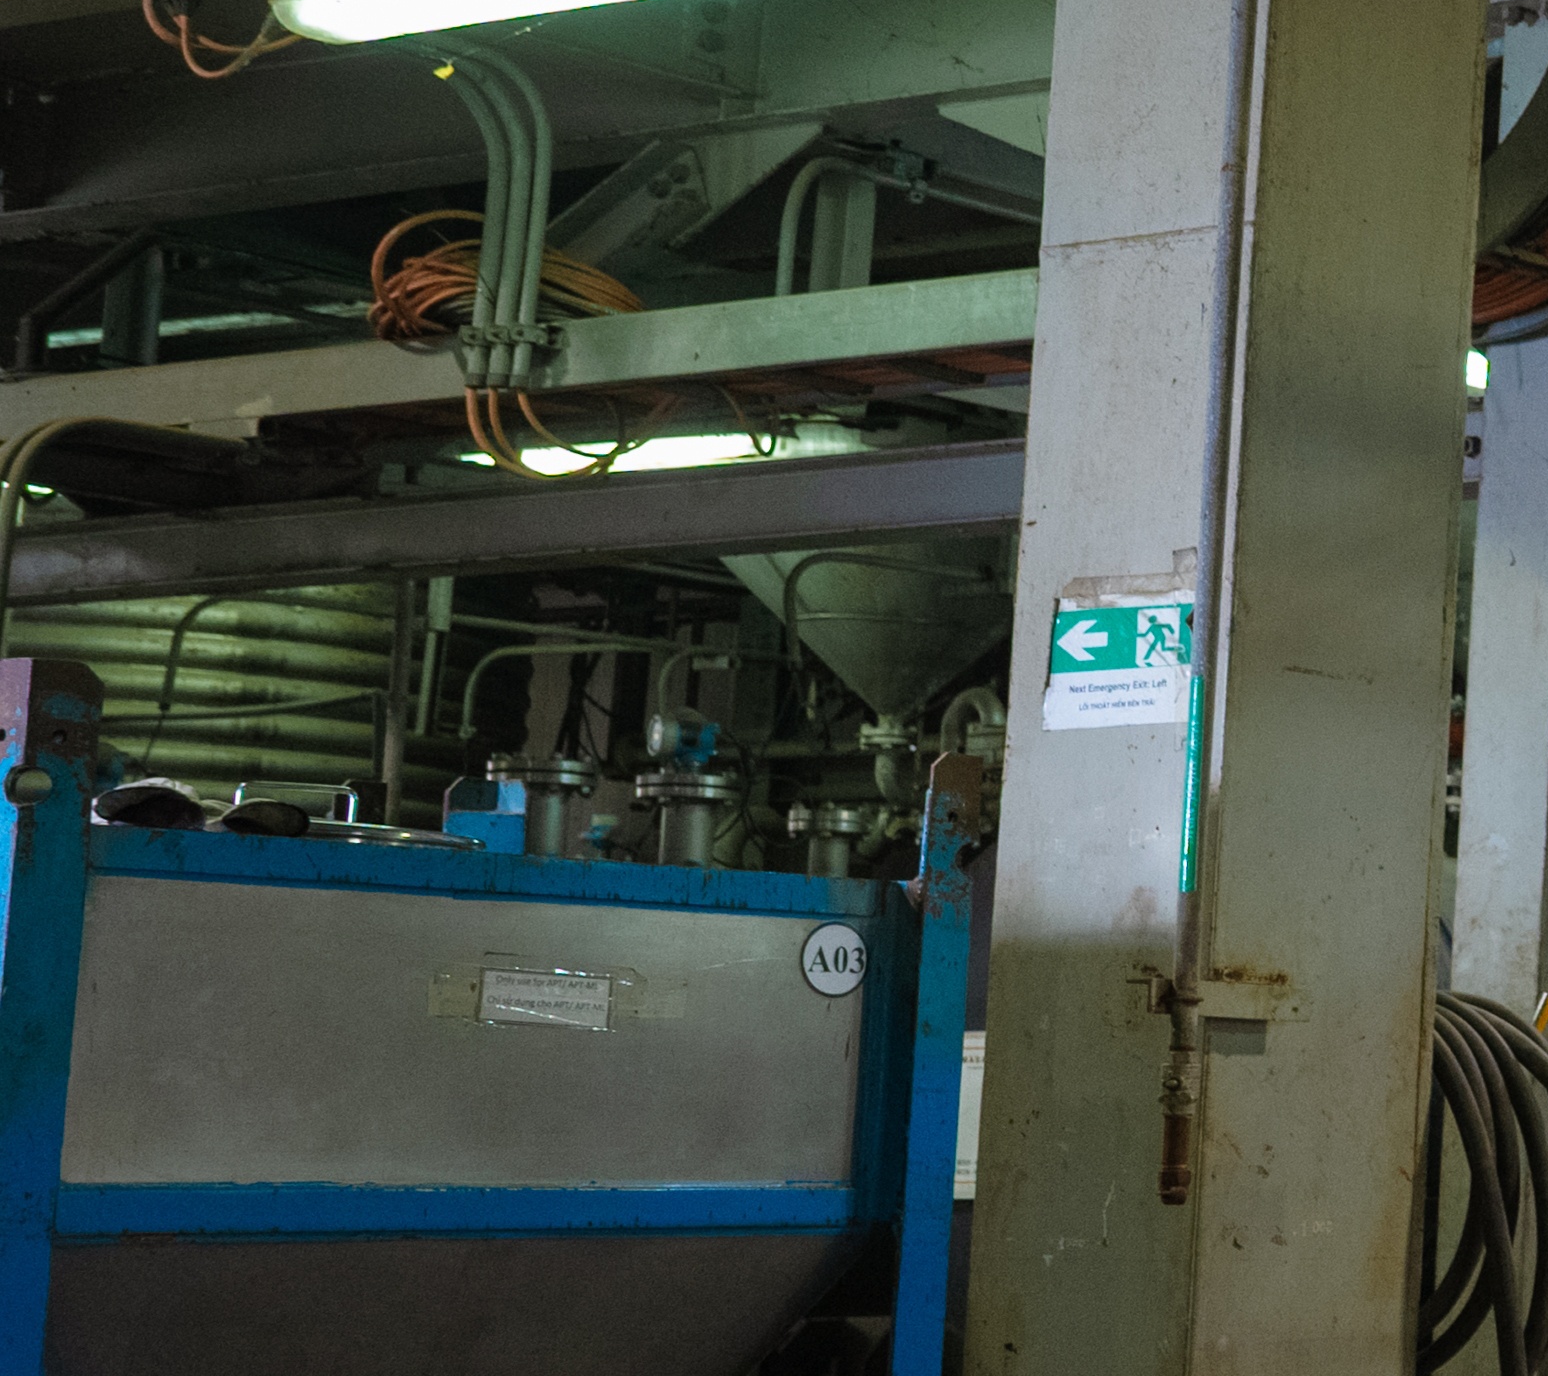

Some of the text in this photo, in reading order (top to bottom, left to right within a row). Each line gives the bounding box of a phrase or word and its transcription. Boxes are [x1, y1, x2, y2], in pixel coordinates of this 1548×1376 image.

[1069, 678, 1167, 694] Next Emergency Exit: Left
[808, 945, 866, 974] A03
[495, 974, 515, 986] Only
[518, 978, 531, 986] use
[533, 978, 545, 988] for
[536, 998, 552, 1008] cho
